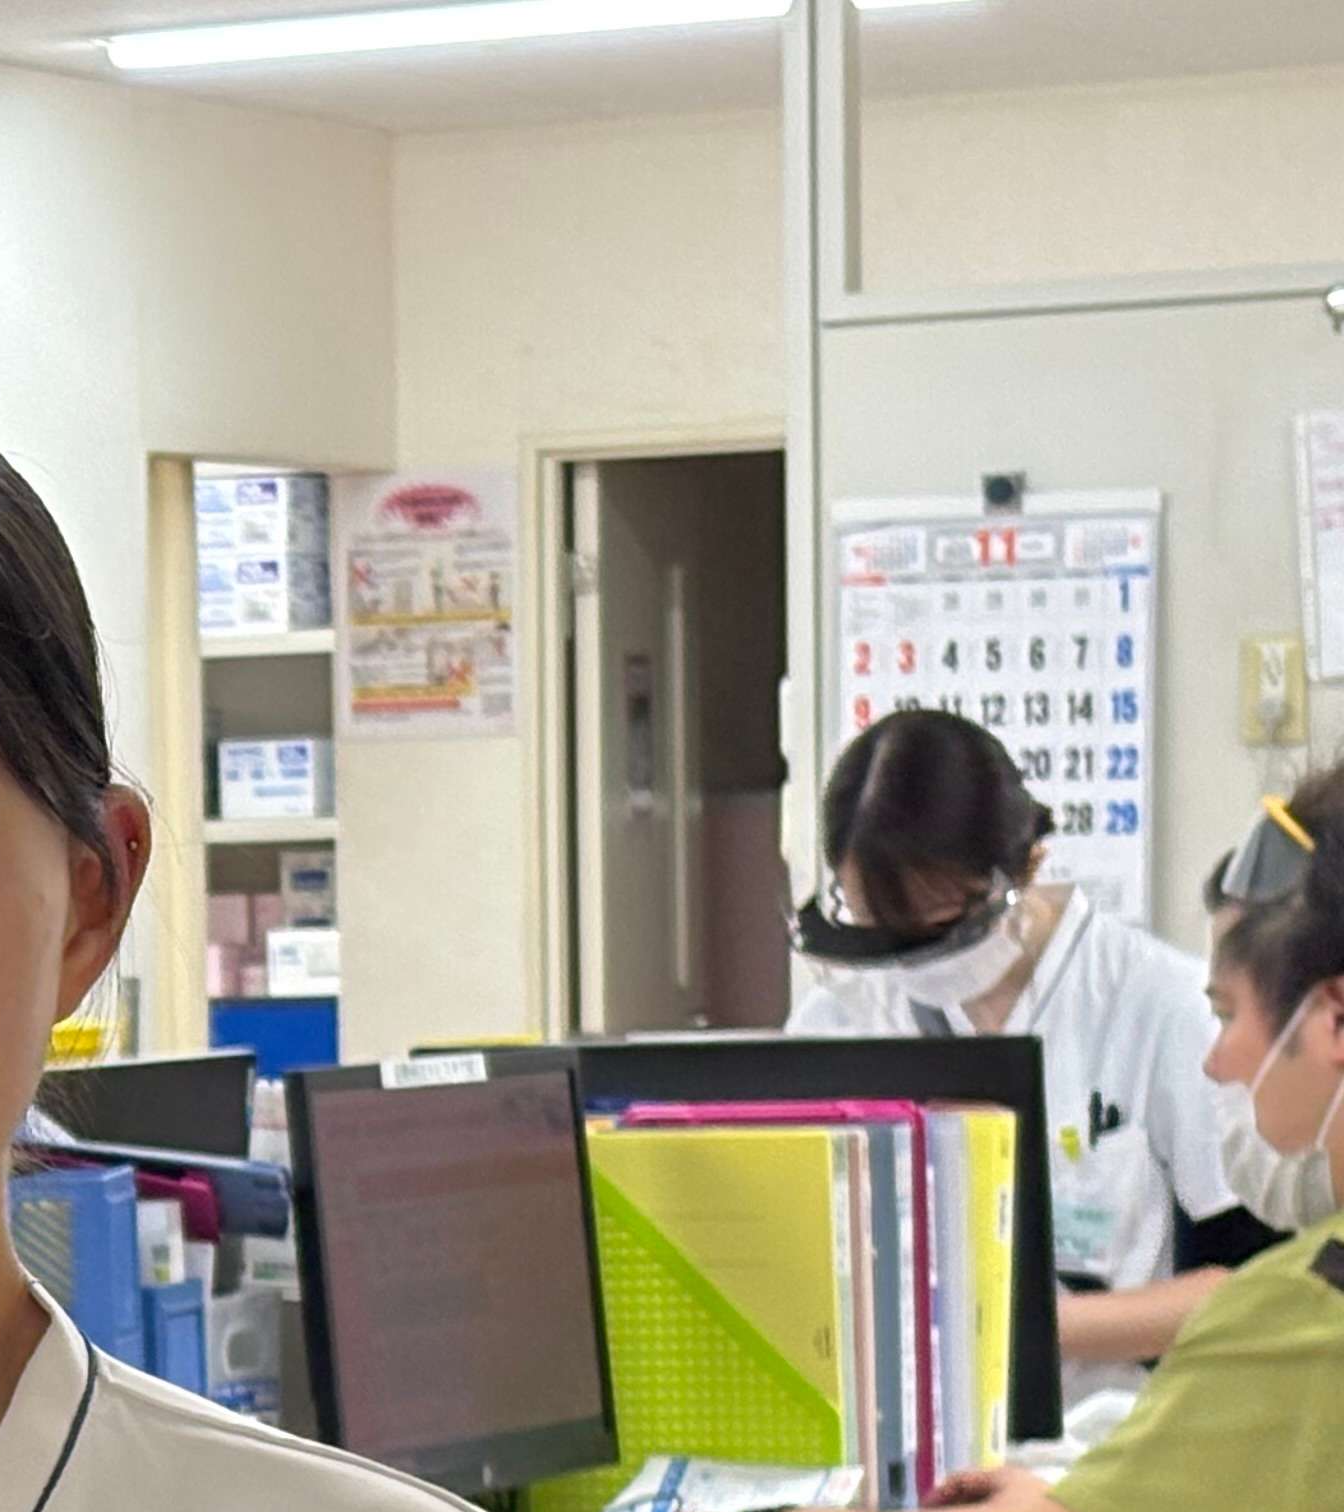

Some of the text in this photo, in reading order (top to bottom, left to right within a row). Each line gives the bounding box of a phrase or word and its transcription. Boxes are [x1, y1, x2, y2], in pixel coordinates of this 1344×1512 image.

[976, 528, 1019, 567] 11
[853, 634, 1134, 676] 2 3 4 5 6 7 8
[854, 695, 872, 729] 9
[981, 691, 1007, 727] 12
[1023, 690, 1050, 726] 13
[1066, 690, 1094, 725] 14
[1111, 689, 1139, 724] 15
[1065, 748, 1094, 782] 21
[1107, 745, 1139, 781] 22
[1063, 801, 1139, 836] 28 29
